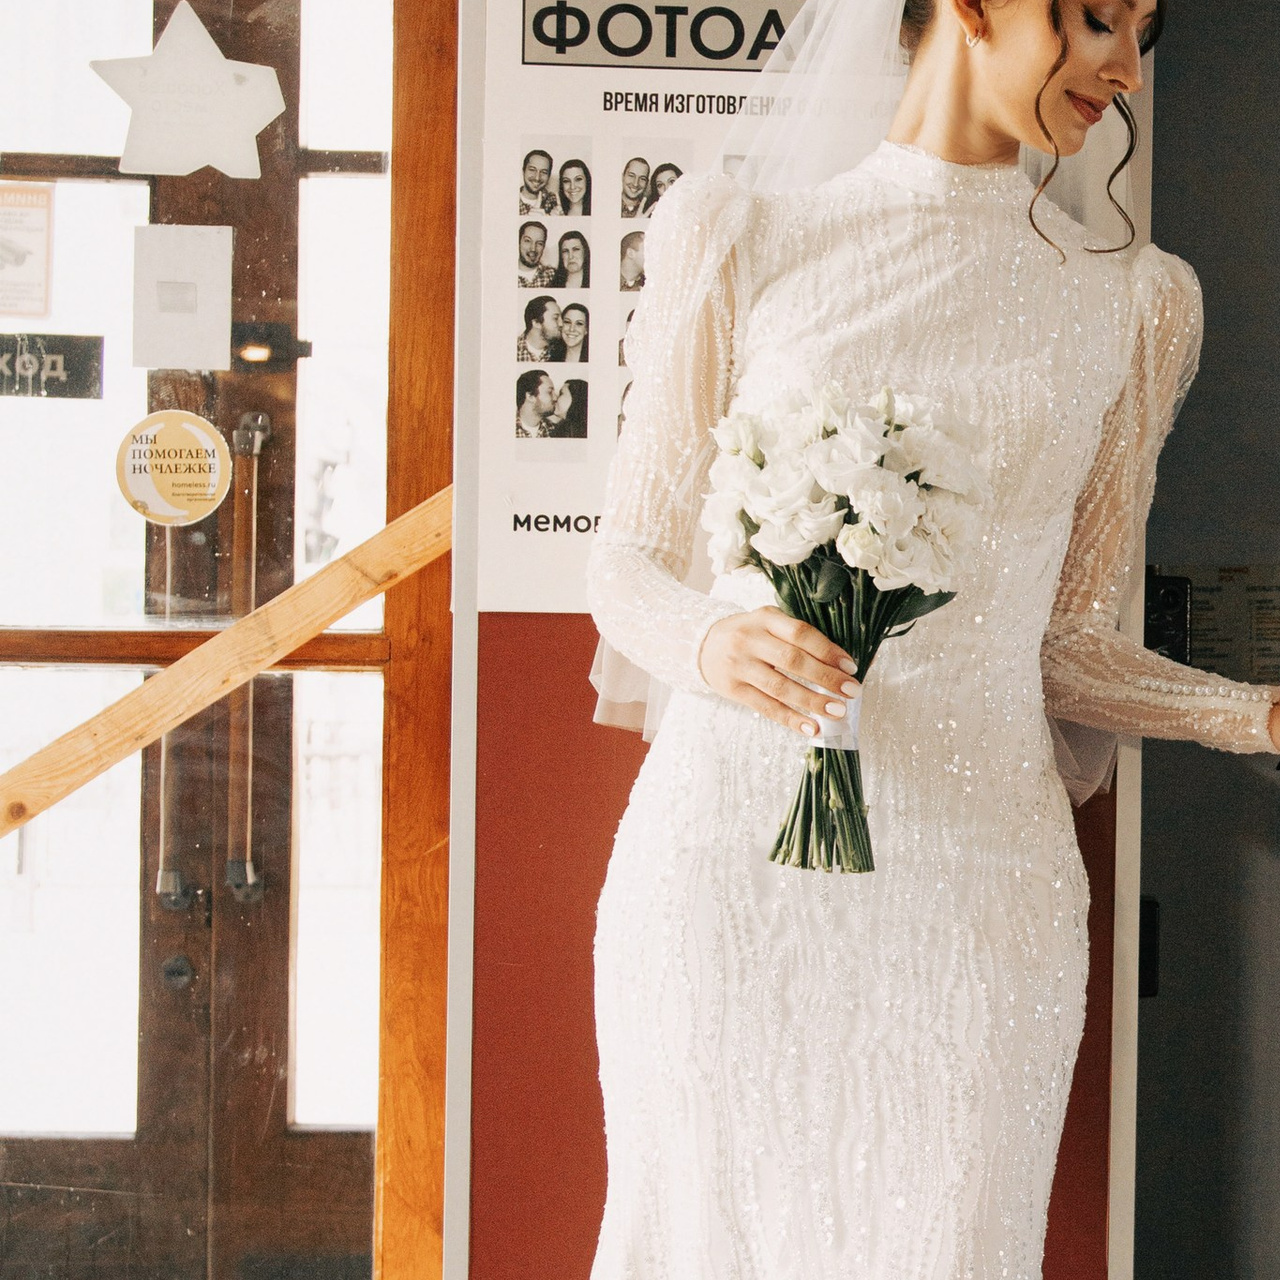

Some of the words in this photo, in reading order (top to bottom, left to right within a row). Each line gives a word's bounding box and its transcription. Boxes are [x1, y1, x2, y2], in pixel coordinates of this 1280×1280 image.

[532, 0, 818, 61] ФОТОА
[603, 91, 659, 112] ВРЕМЯ
[131, 434, 158, 445] МЫ
[131, 448, 217, 460] ПОМОГАЕМ
[131, 463, 217, 475] НОЧЛЕЖКЕ
[171, 480, 217, 488] homeless.ru
